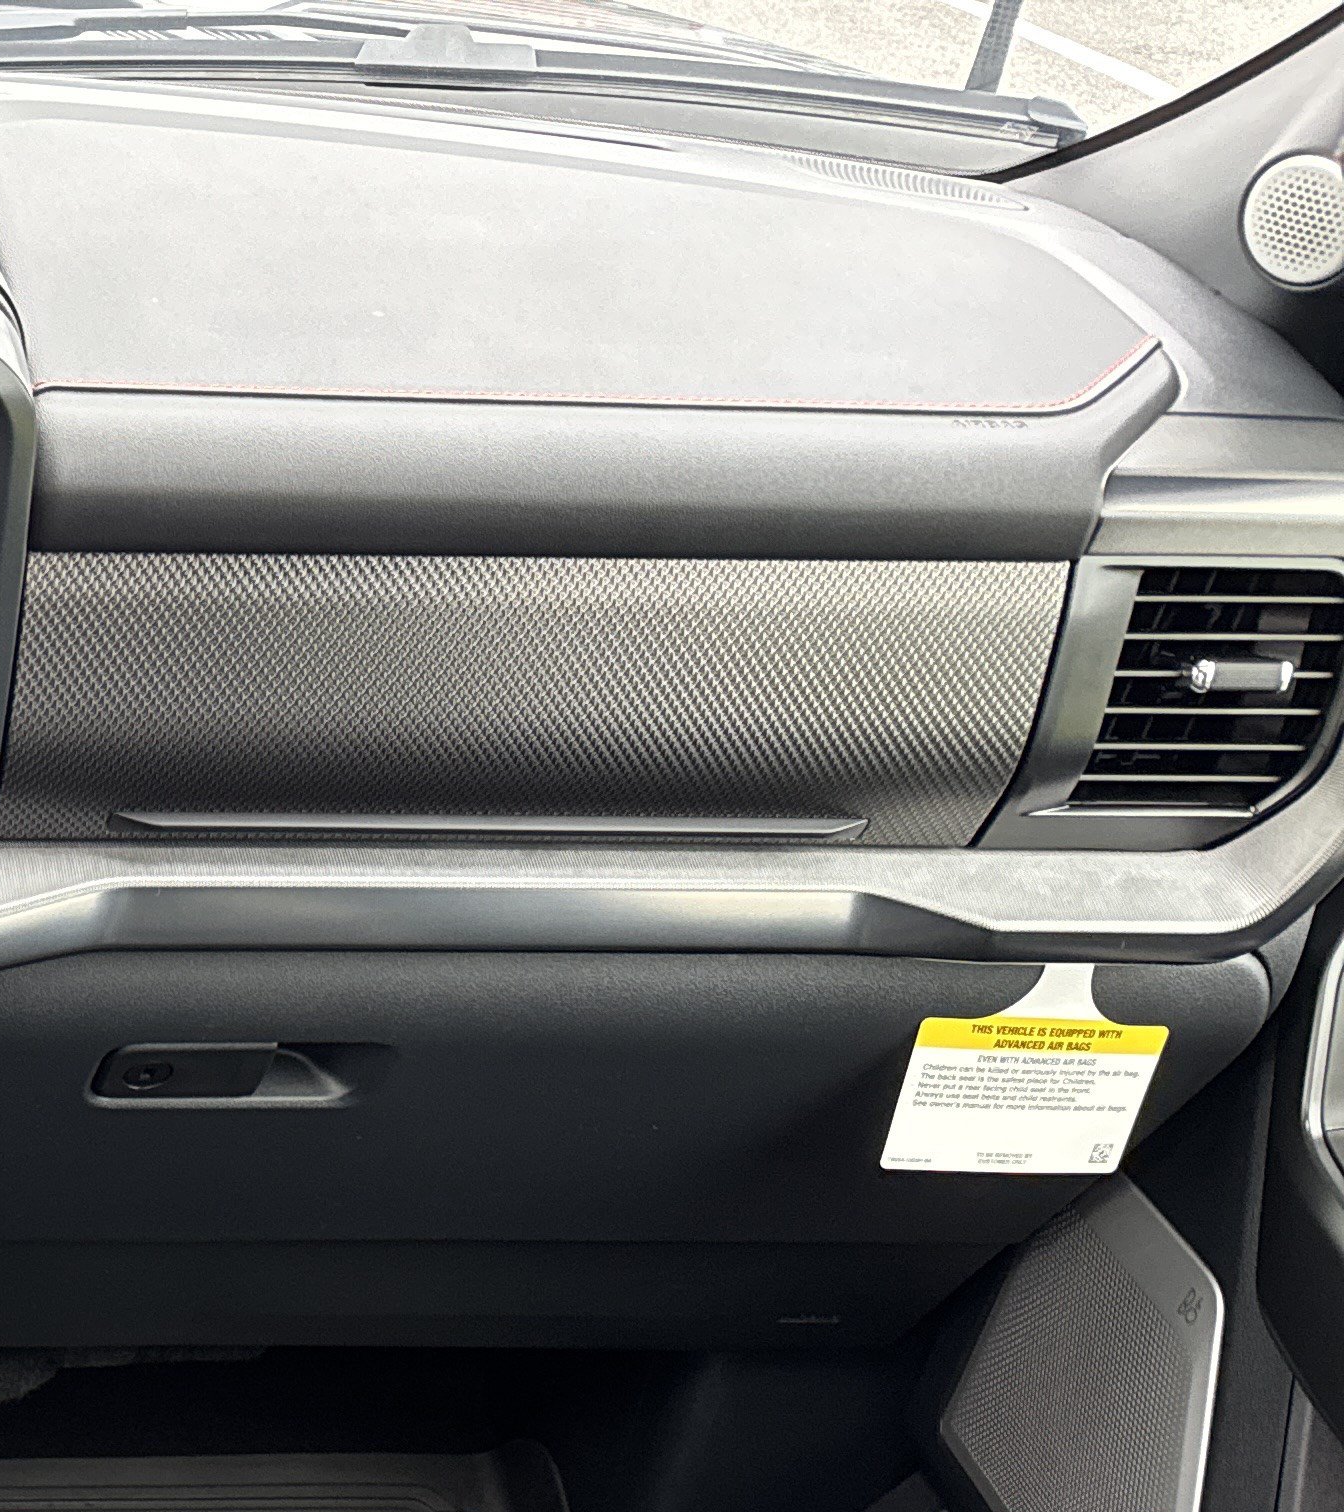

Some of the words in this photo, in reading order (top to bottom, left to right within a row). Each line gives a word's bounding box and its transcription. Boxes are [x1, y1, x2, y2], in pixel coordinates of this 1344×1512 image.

[972, 1024, 994, 1035] THIS
[996, 1026, 1036, 1037] VEHICLE
[1037, 1028, 1047, 1038] IS
[1049, 1028, 1096, 1039] EQUIPPED
[1098, 1030, 1123, 1039] WITH
[993, 1039, 1046, 1050] ADVANCED
[1047, 1041, 1065, 1051] AIR
[1065, 1042, 1093, 1051] BAGS
[977, 1055, 998, 1063] EVEN
[1000, 1056, 1020, 1064] WITH
[1021, 1057, 1061, 1065] ADVANCED
